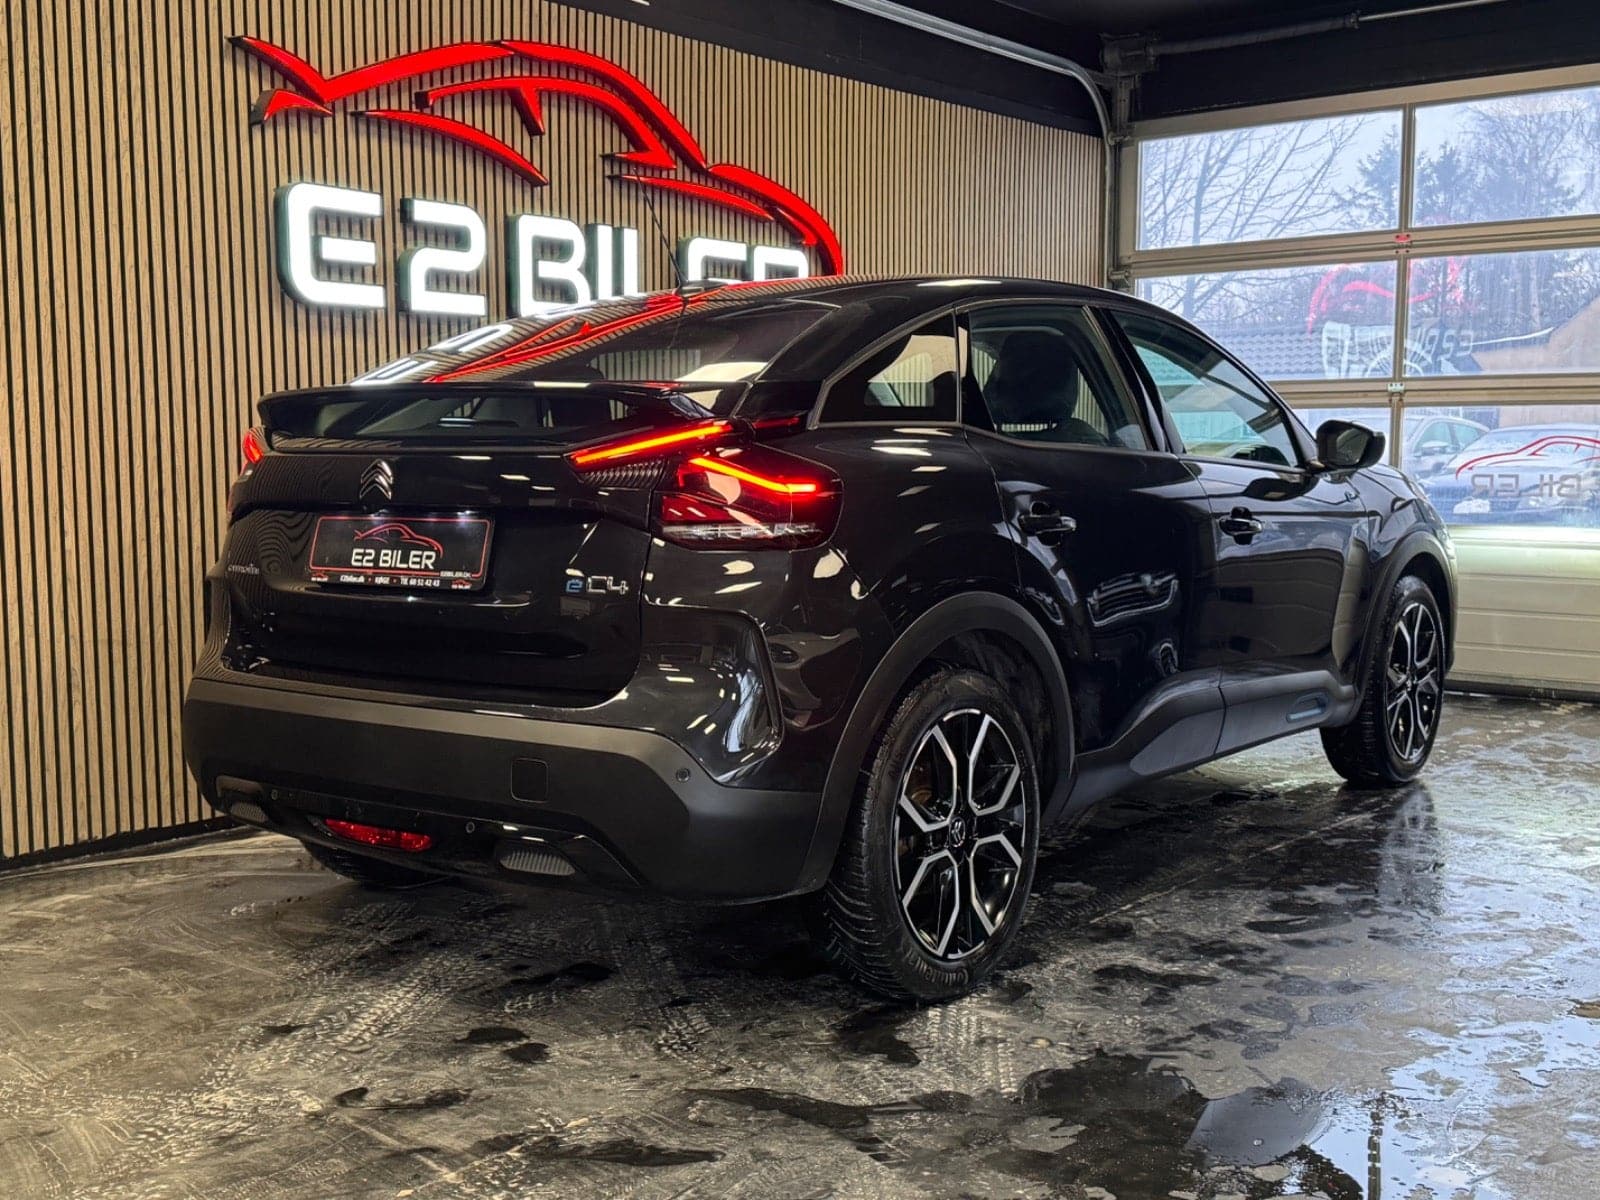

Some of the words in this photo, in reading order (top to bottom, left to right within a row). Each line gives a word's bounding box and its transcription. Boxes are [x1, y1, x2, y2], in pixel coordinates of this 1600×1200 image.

[275, 182, 487, 317] E2
[351, 548, 375, 567] E2
[379, 549, 437, 570] BILER
